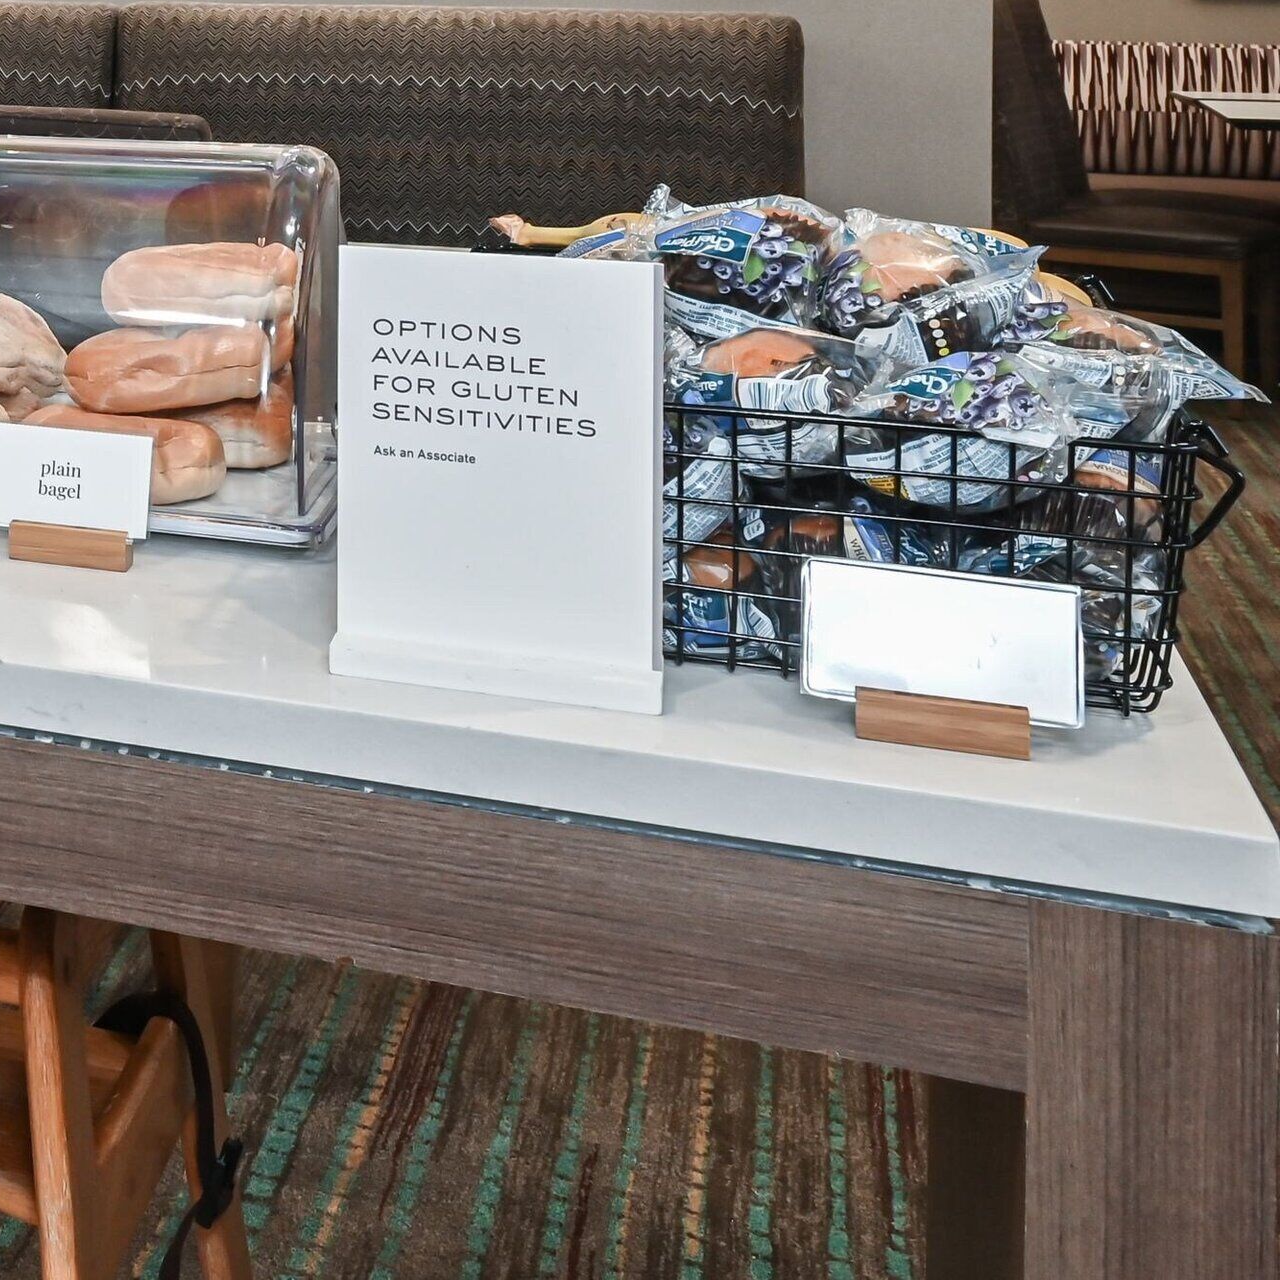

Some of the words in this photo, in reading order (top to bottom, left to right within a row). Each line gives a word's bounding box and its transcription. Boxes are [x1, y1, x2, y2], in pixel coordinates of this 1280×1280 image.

[372, 317, 522, 345] OPTIONS
[371, 346, 546, 376] AVAILABLE
[373, 374, 436, 396] FOR
[451, 380, 579, 407] GLUTEN
[372, 401, 597, 438] SENSITIVITIES
[40, 459, 82, 479] plain
[373, 445, 397, 458] Ask
[399, 449, 414, 459] an
[417, 448, 476, 465] Associate
[38, 479, 82, 500] bagel
